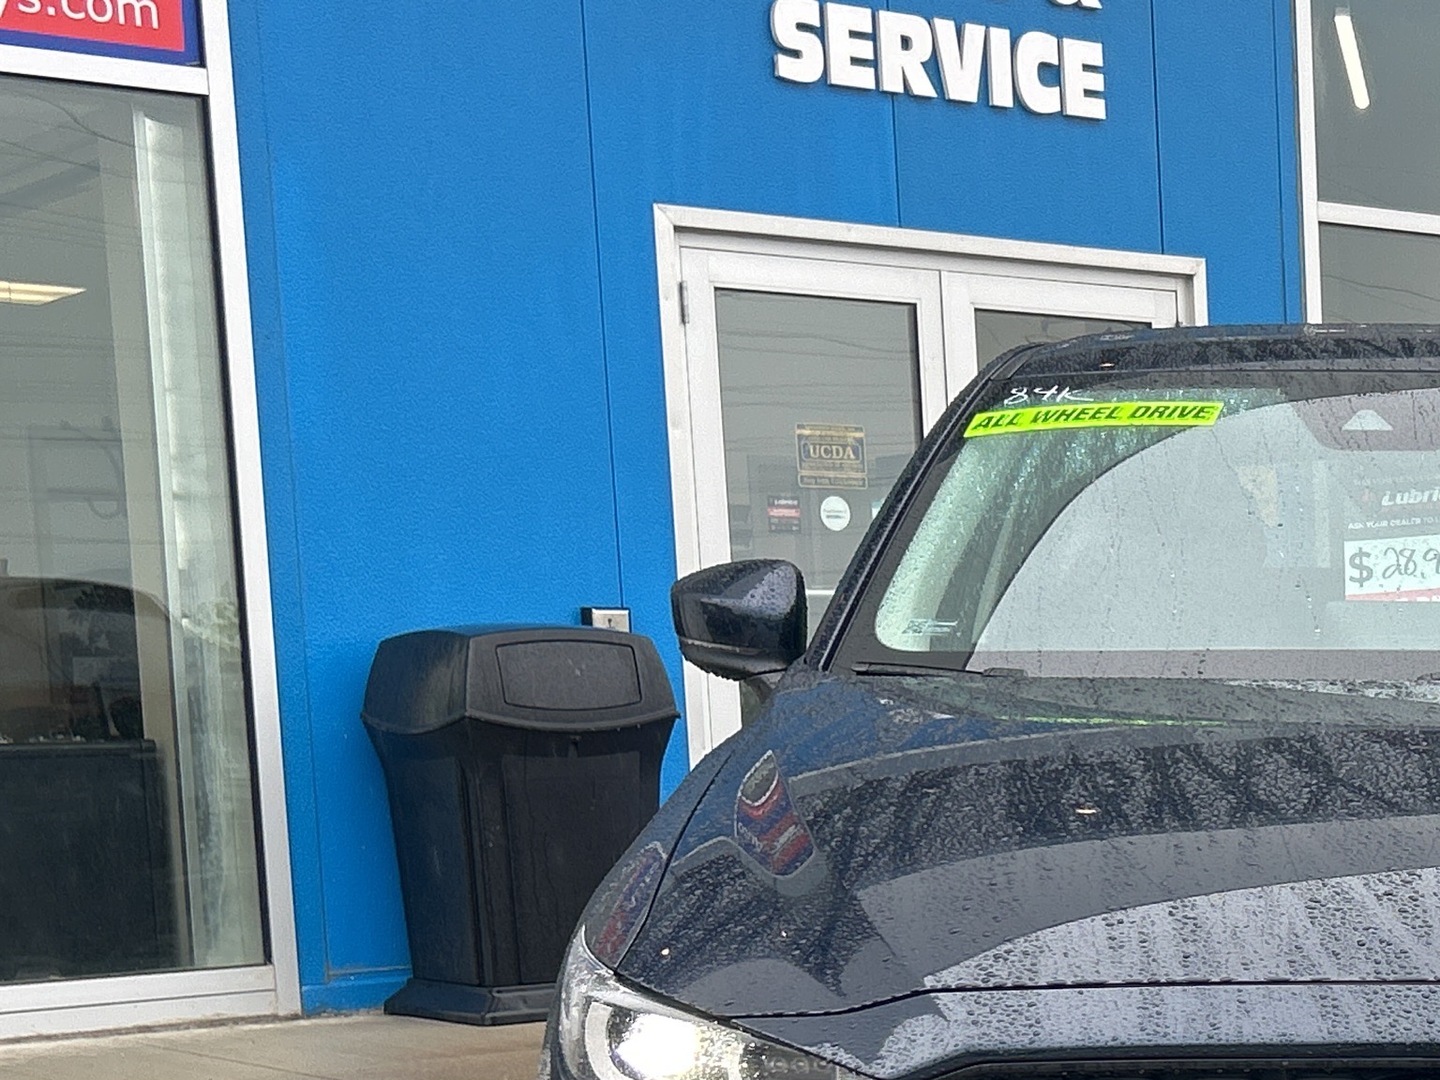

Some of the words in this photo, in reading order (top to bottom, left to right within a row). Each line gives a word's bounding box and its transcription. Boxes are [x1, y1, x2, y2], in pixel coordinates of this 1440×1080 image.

[771, 0, 1106, 120] SERVICE
[971, 413, 1021, 432] ALL
[1030, 405, 1119, 424] WHEEL
[1127, 404, 1215, 421] DRIVE
[809, 444, 856, 460] UCDA
